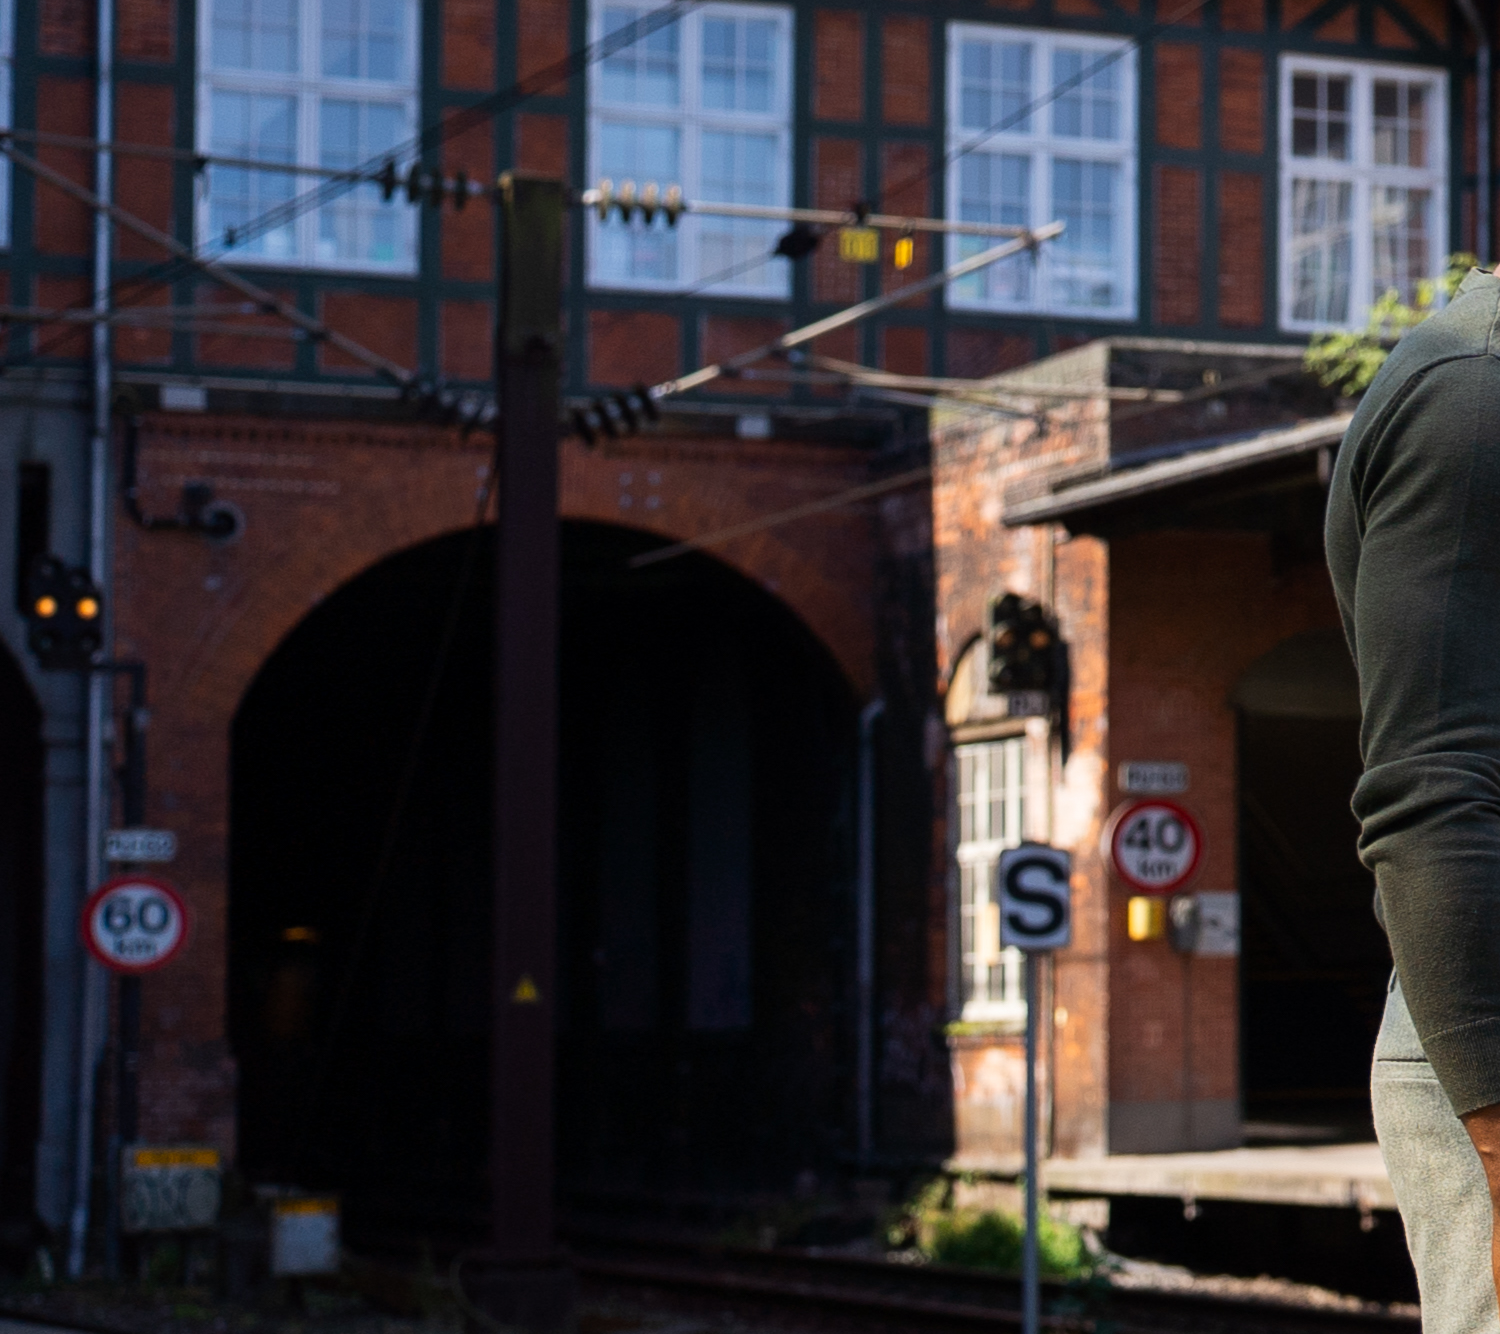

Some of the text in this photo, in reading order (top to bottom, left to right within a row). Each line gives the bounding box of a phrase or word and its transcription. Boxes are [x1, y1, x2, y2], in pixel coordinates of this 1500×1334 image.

[1124, 816, 1185, 854] 40
[103, 897, 168, 934] 60
[1005, 857, 1067, 936] S
